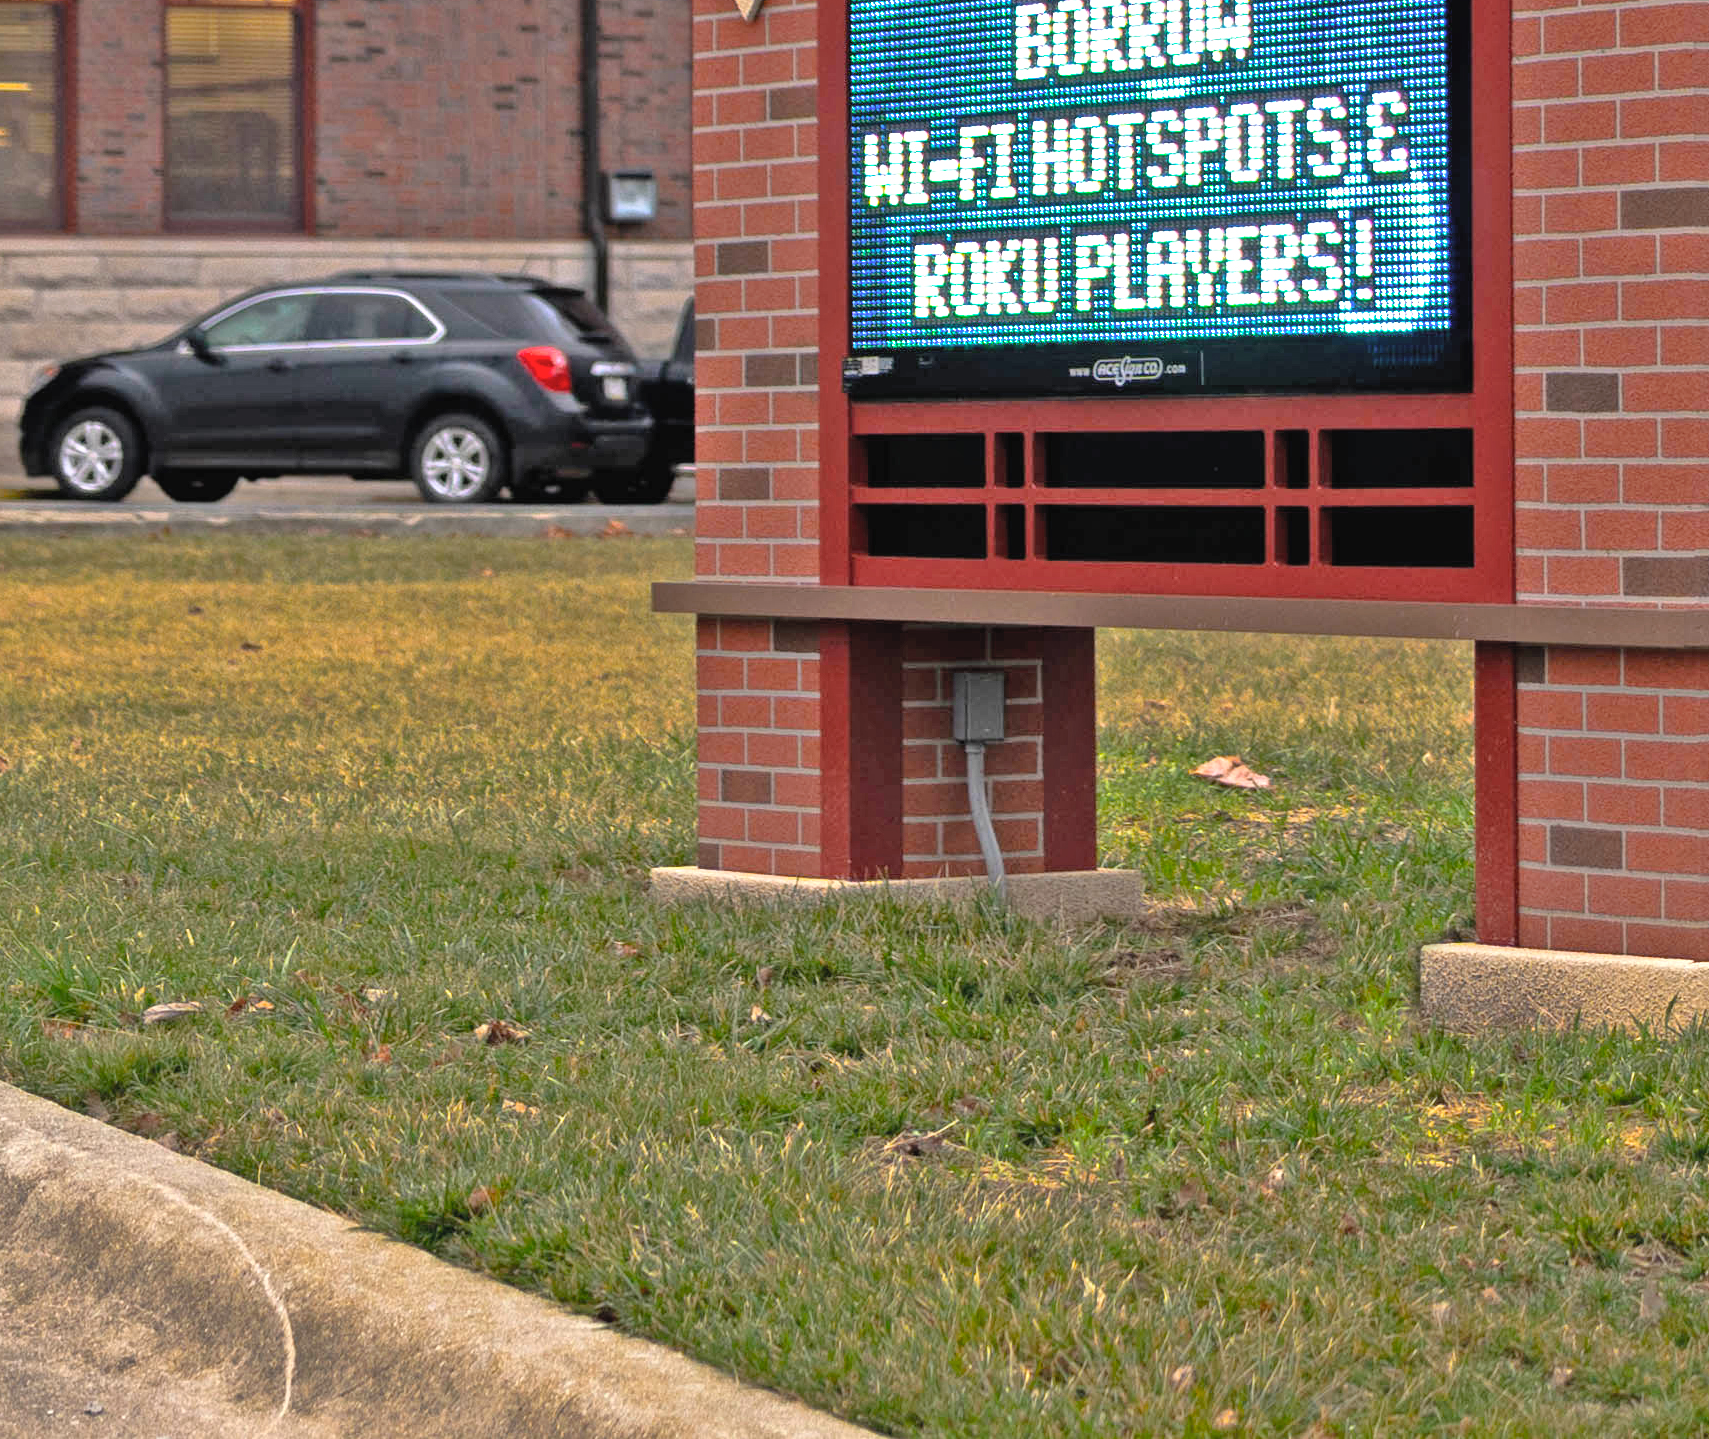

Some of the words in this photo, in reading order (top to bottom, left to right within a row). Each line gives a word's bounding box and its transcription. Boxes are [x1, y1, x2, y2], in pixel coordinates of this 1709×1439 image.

[863, 122, 1016, 207] WI-FI
[1032, 96, 1348, 197] HOTSPOTS
[913, 237, 1060, 319] ROKU
[1075, 218, 1375, 312] PLAYERS!
